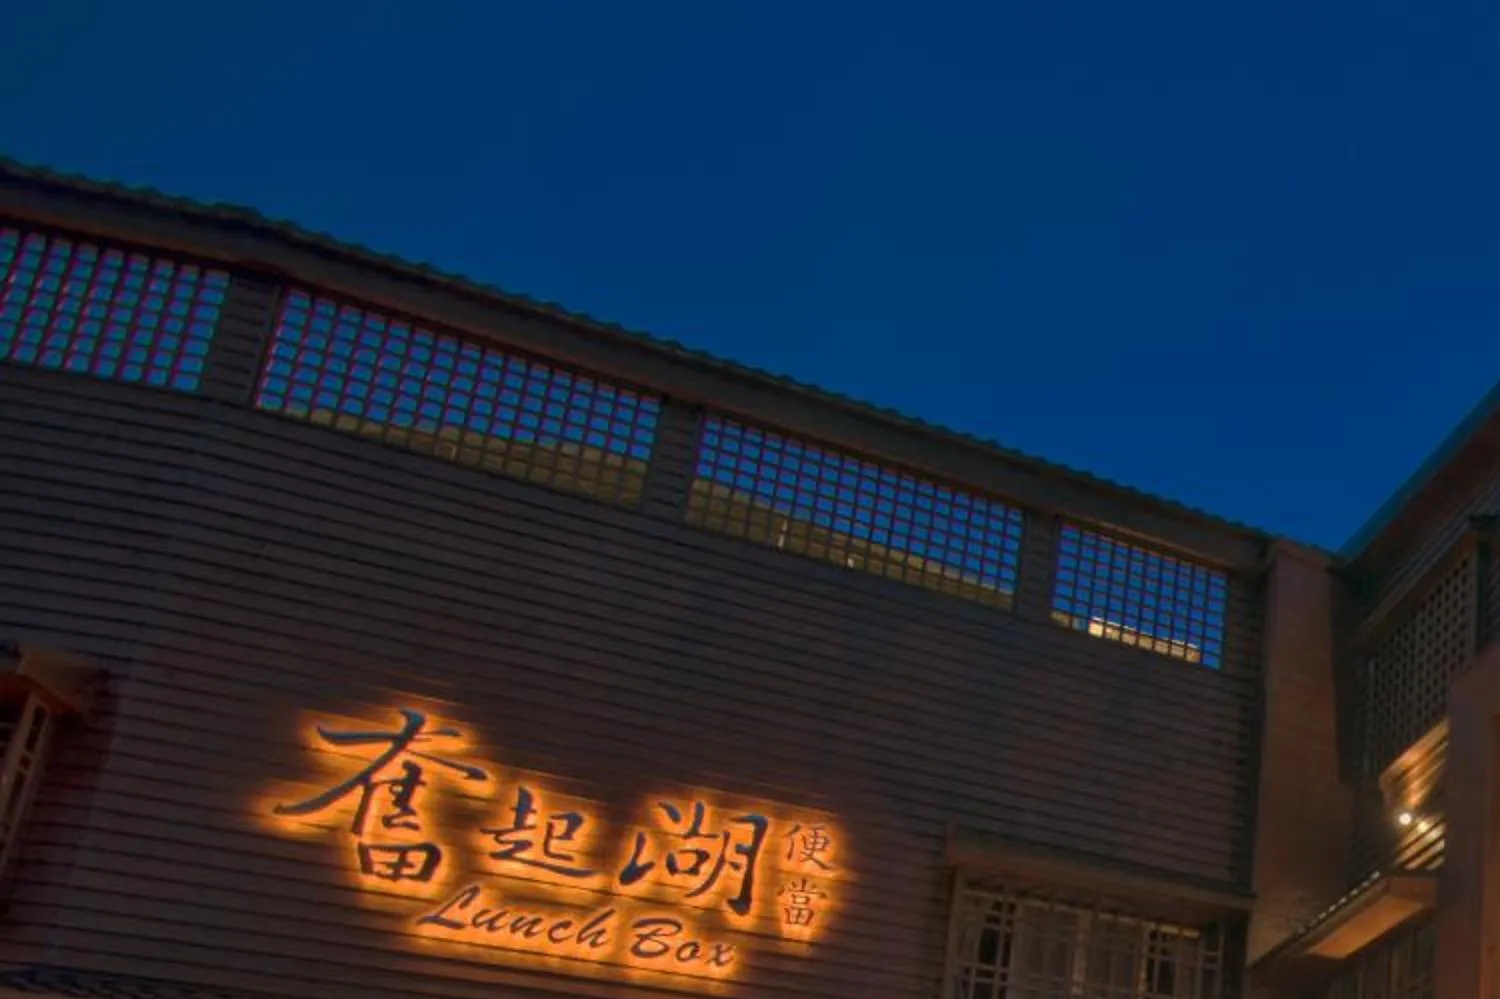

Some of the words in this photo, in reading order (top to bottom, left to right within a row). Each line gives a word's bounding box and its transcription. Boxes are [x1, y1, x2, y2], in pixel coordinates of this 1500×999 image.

[272, 709, 768, 915] 奮起湖
[416, 882, 612, 948] Lunch
[629, 917, 738, 968] Box
[776, 823, 835, 928] 便當
